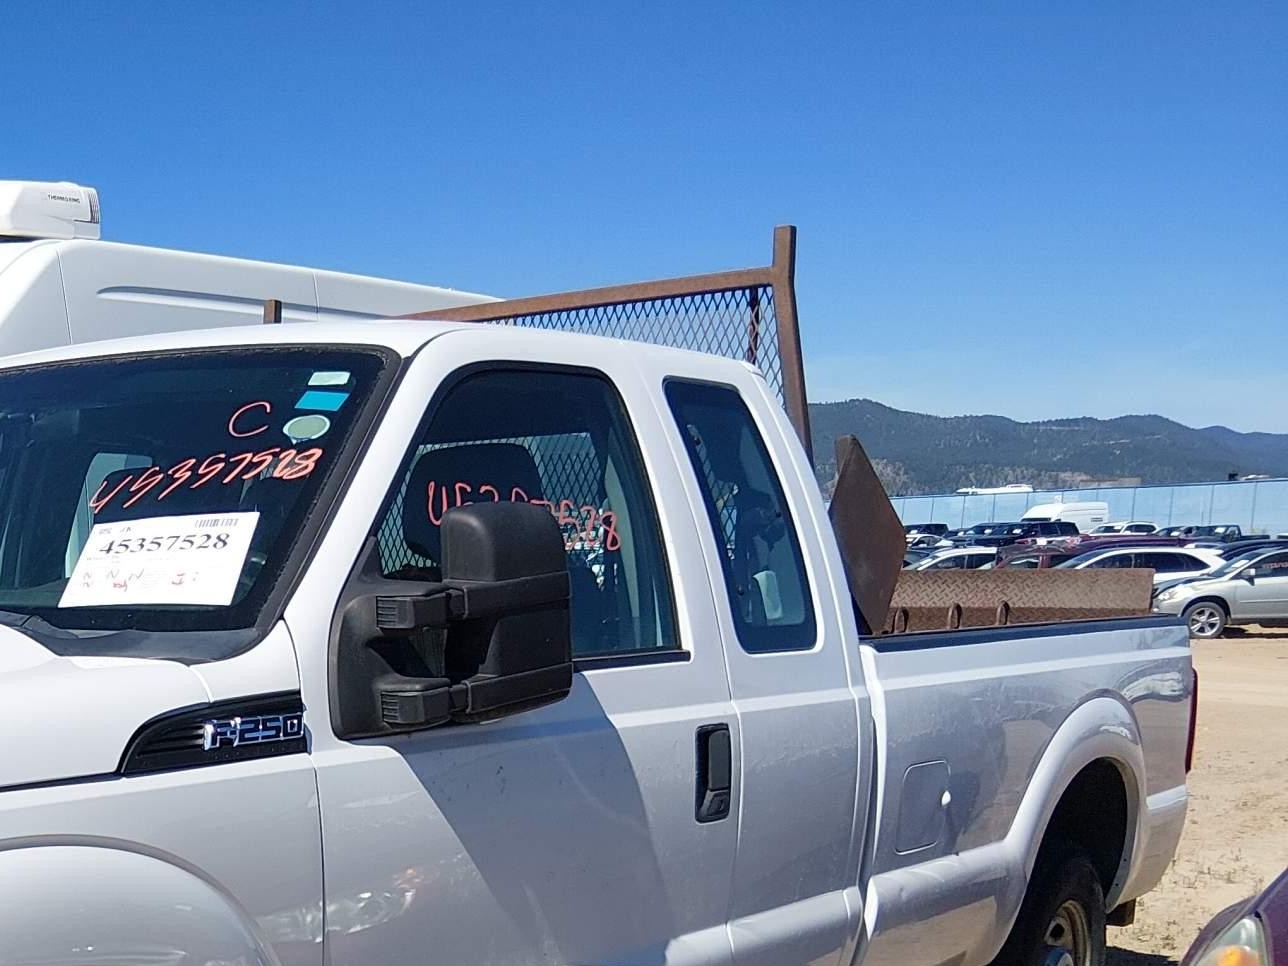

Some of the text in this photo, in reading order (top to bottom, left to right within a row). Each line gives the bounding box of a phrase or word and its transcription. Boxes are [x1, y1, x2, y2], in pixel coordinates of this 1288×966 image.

[228, 401, 271, 438] C
[89, 447, 323, 515] 45357528
[98, 532, 231, 555] 45357528
